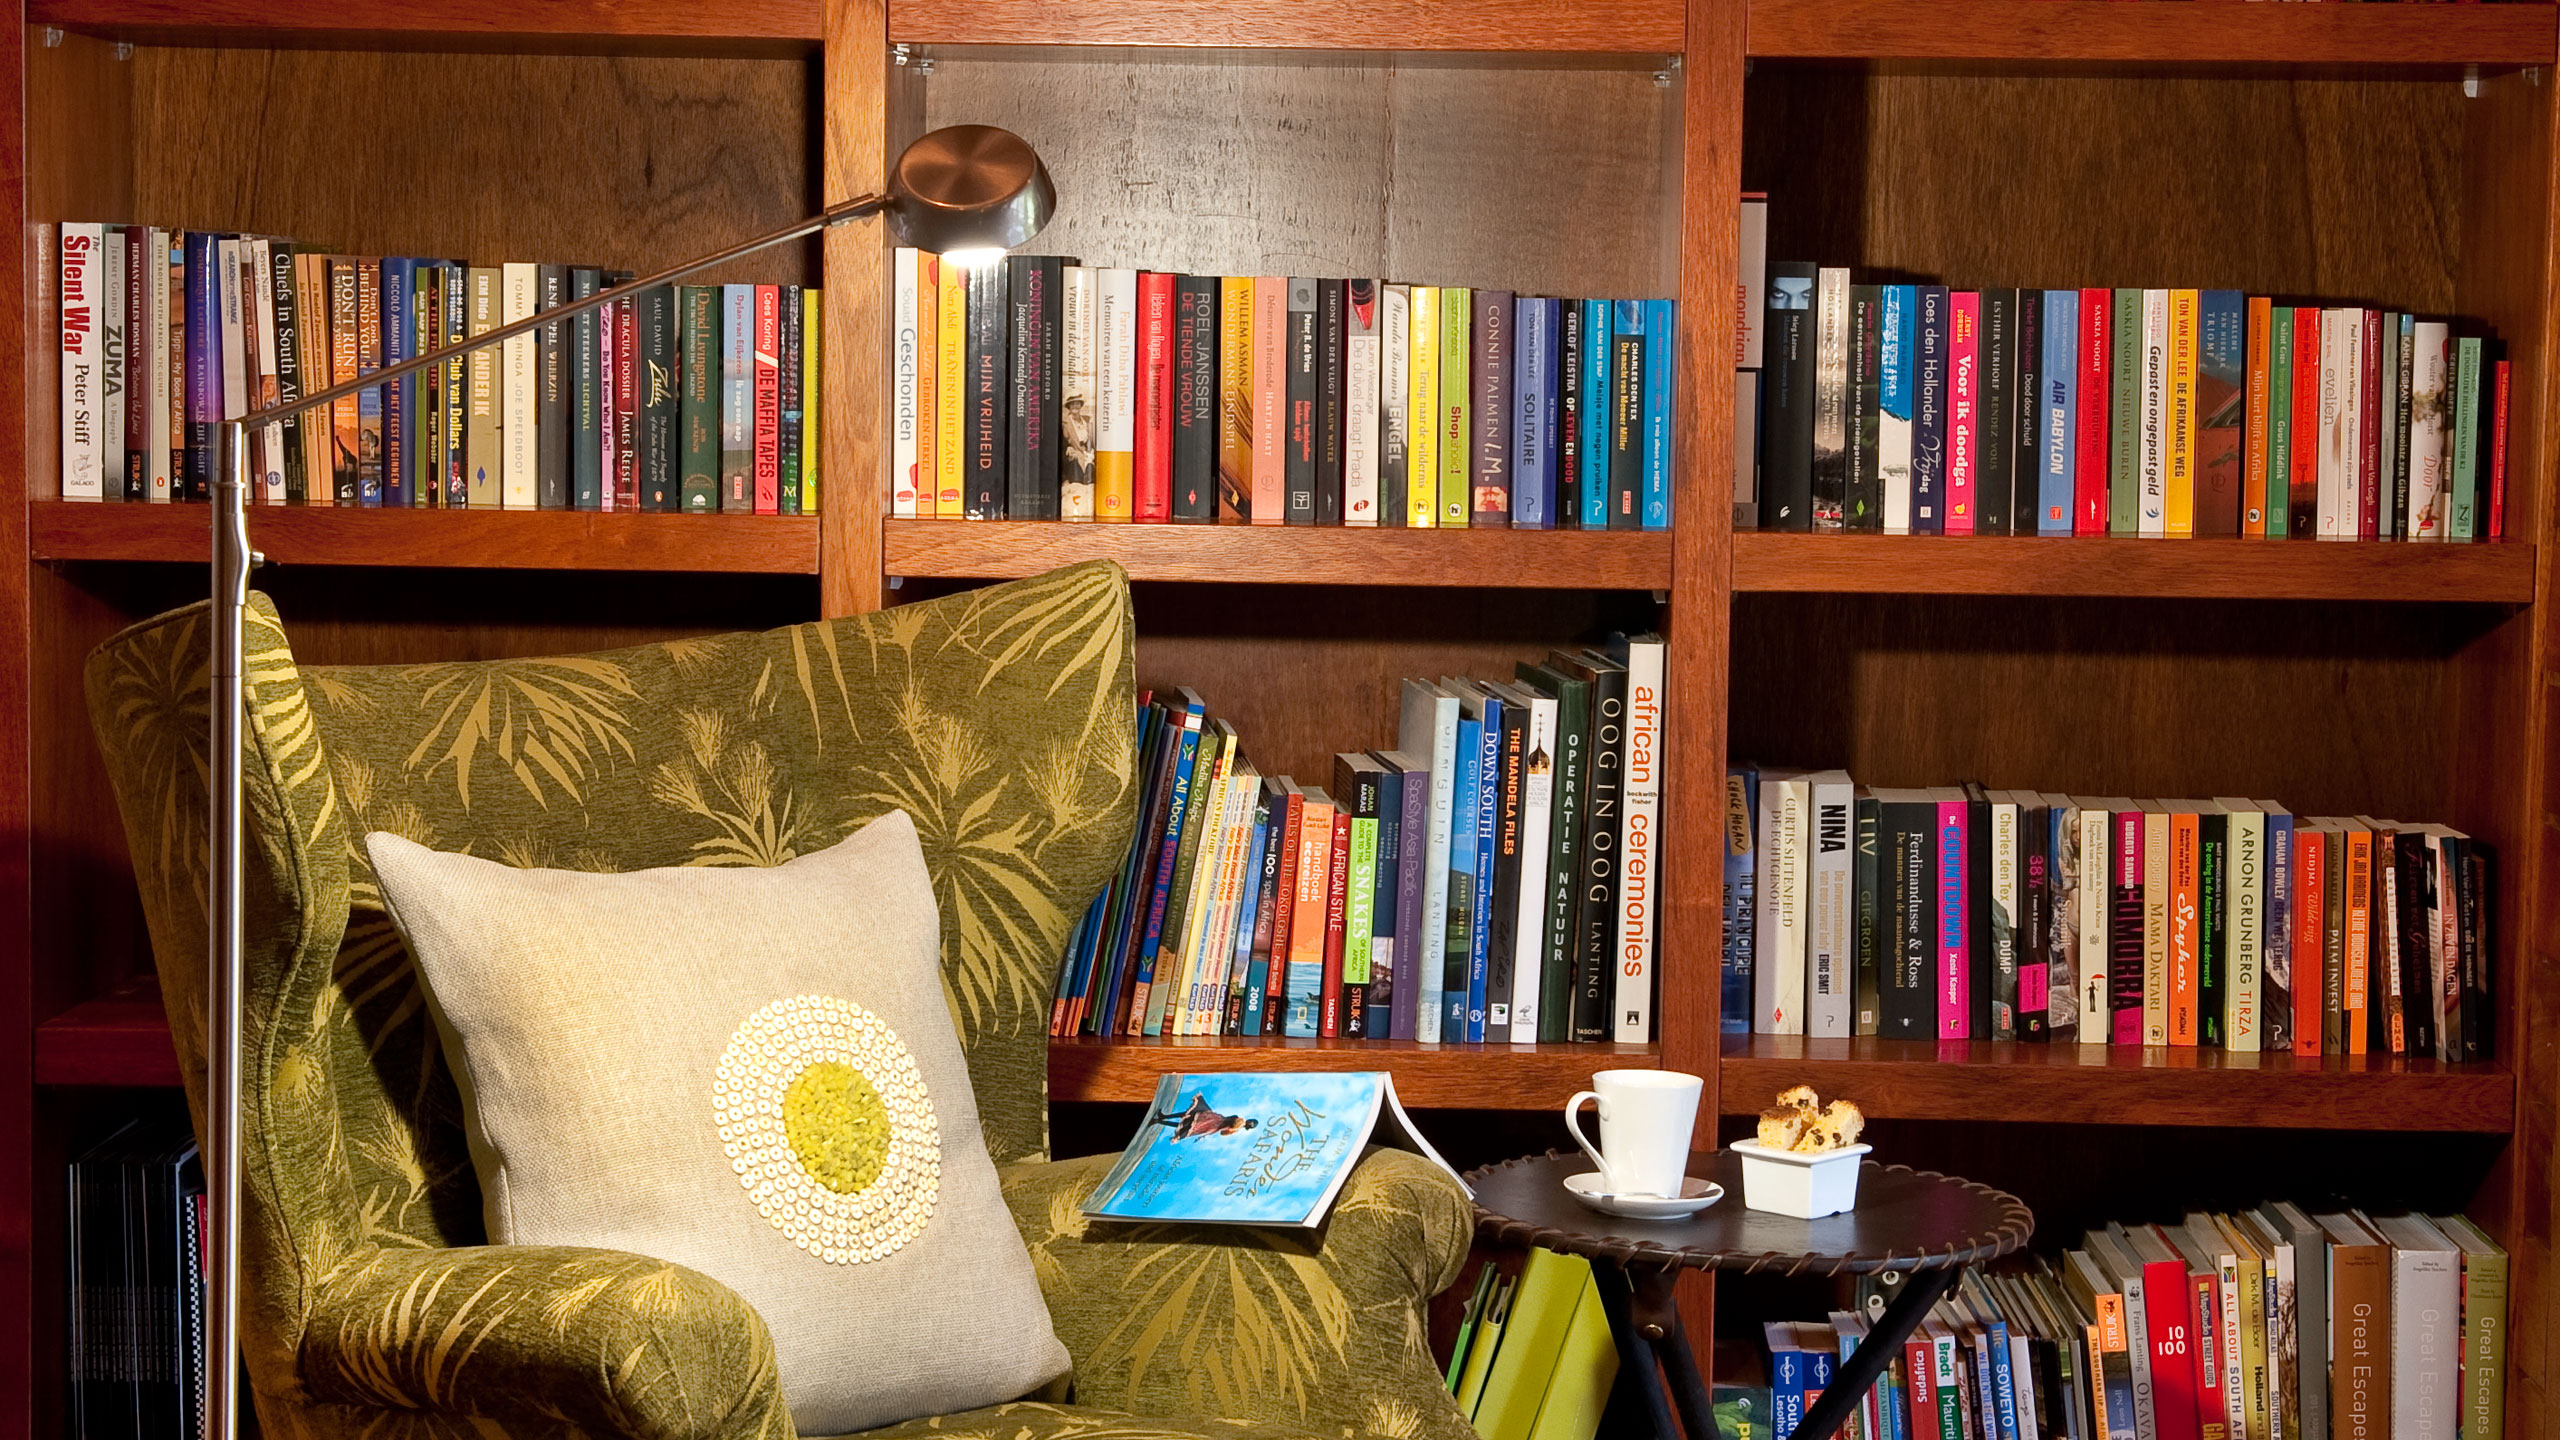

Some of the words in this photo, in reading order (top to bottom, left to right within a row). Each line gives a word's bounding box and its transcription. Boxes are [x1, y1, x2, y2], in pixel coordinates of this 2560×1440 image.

[92, 235, 100, 251] The
[64, 235, 90, 301] Silent
[275, 254, 294, 301] Chiefs
[279, 307, 295, 322] in
[334, 275, 343, 326] whatever
[342, 275, 356, 327] DON'T
[360, 273, 369, 325] BEHIND
[654, 298, 662, 321] SAUL
[698, 293, 710, 329] David
[1182, 292, 1194, 311] DE
[1197, 292, 1210, 338] ROEL
[1240, 289, 1249, 338] WILLEM
[1925, 294, 1939, 323] Loes
[1992, 301, 2001, 340] ESTHER
[2179, 298, 2189, 316] TON
[64, 307, 90, 355] War
[132, 322, 140, 357] BOSMAN
[333, 328, 343, 348] you
[360, 327, 370, 358] YOU!
[622, 314, 631, 357] DRACULA
[654, 325, 662, 355] DAVID
[1016, 303, 1027, 346] Jacqueline
[1104, 295, 1114, 347] Memoires
[1119, 311, 1130, 343] Farah
[1181, 317, 1193, 368] TIENDE
[1488, 305, 1500, 369] CONNIE
[1736, 285, 1752, 362] mondrian
[2178, 319, 2189, 336] VAN
[106, 325, 122, 397] ZUMA
[279, 328, 297, 375] South
[335, 351, 344, 366] do
[343, 334, 357, 367] RUN
[1119, 346, 1130, 370] Diba
[1353, 339, 1365, 358] De
[1924, 329, 1938, 357] den
[2093, 340, 2101, 373] NOORT
[2178, 340, 2188, 357] DER
[74, 364, 89, 405] Peter
[622, 362, 631, 399] DOSSIER
[691, 333, 710, 403] Livingstone
[759, 369, 774, 385] DE
[900, 328, 916, 440] Geschonden
[980, 355, 992, 394] MIJN
[1015, 347, 1027, 383] Kennedy
[1195, 342, 1209, 419] JANSSEN
[1352, 362, 1364, 400] duivel
[1418, 370, 1429, 397] Terug
[1958, 355, 1971, 396] Voor
[1991, 344, 2000, 390] VERHOEF
[2178, 361, 2188, 377] LEE
[1016, 385, 1026, 417] Onassis
[1118, 374, 1128, 416] Pahlawi
[1180, 373, 1192, 427] VROUW
[1487, 376, 1499, 437] PALMEN
[1923, 360, 1938, 427] Hollander
[1957, 401, 1970, 419] ik
[2052, 380, 2066, 404] AIR
[2177, 383, 2187, 395] DE
[2324, 369, 2337, 426] evelien
[74, 410, 90, 445] Stiff
[620, 410, 633, 444] JAMES
[759, 389, 774, 435] MAFFIA
[1102, 390, 1112, 432] keizerin
[1350, 404, 1364, 445] draagt
[1419, 402, 1427, 424] naar
[1419, 427, 1428, 438] de
[1524, 393, 1535, 466] SOLITAIRE
[2176, 398, 2187, 453] AFRIKAANSE
[980, 398, 992, 469] VRIJHEID
[1387, 407, 1402, 464] ENGEL
[2051, 408, 2063, 474] BABYLON
[622, 450, 633, 483] REESE
[759, 440, 774, 477] TAPES
[1418, 442, 1428, 488] wildernis
[1953, 425, 1968, 487] doodga
[2175, 457, 2186, 477] WEG
[2423, 456, 2437, 491] Door
[1509, 728, 1521, 753] THE
[1598, 697, 1621, 769] OOG
[1632, 686, 1658, 783] african
[1484, 732, 1497, 781] DOWN
[1176, 776, 1190, 796] All
[1505, 756, 1520, 818] MANDELA
[1561, 734, 1579, 854] OPERATIE
[1596, 783, 1616, 818] IN
[1166, 796, 1186, 836] About
[1479, 785, 1495, 838] SOUTH
[1771, 810, 1781, 828] DE
[1784, 798, 1795, 844] CURTIS
[1820, 804, 1846, 853] NINA
[1503, 821, 1515, 855] FILES
[2000, 813, 2011, 856] Charles
[2276, 830, 2286, 865] GRAHAM
[1157, 839, 1177, 887] SOUTH
[1300, 841, 1313, 902] ecoreizen
[1311, 841, 1325, 902] handboek
[1331, 848, 1346, 896] AFRICAN
[1589, 832, 1612, 903] OOG
[1769, 831, 1781, 915] ECHTGENOTE
[2000, 860, 2011, 880] den
[2241, 827, 2254, 888] ARNON
[1353, 865, 1371, 938] SNAKES
[1624, 814, 1649, 977] ceremonies
[1783, 848, 1794, 927] SITTENFELD
[1909, 832, 1923, 933] Ferdinandusse
[1944, 826, 1961, 948] COUNTDOWN
[2000, 883, 2011, 902] Tex
[2274, 867, 2285, 899] BOWLEY
[1148, 889, 1168, 938] AFRICA
[1329, 898, 1343, 931] STYLE
[1554, 872, 1568, 961] NATUUR
[2150, 903, 2162, 946] MAMA
[1587, 922, 1602, 999] LANTING
[1909, 939, 1921, 950] &
[1999, 940, 2011, 974] DUMP
[2114, 884, 2144, 1012] GOMORRA
[2175, 893, 2194, 994] Spyker
[2240, 894, 2253, 984] GRUNBERG
[2328, 929, 2338, 963] PALM
[1908, 955, 1921, 988] Ross
[2150, 951, 2162, 1010] DAKTARI
[2328, 968, 2338, 1013] INVEST
[1249, 986, 1260, 1012] 2008
[1327, 998, 1335, 1029] TASCHEN
[2239, 991, 2251, 1036] TIRZA
[1223, 1115, 1287, 1198] SAFARIS
[1298, 1135, 1331, 1173] THE
[2133, 1311, 2143, 1336] Frans
[2226, 1293, 2235, 1315] ALL
[2228, 1321, 2237, 1361] ABOUT
[2353, 1304, 2371, 1358] Great
[2421, 1309, 2439, 1363] Great
[2480, 1317, 2495, 1360] Great
[1915, 1350, 1927, 1403] Sudafrica
[1939, 1343, 1951, 1376] Bradt
[2135, 1338, 2144, 1372] Lanting
[1996, 1364, 2013, 1427] SOWETO
[2230, 1367, 2241, 1413] SOUTH
[2255, 1366, 2265, 1411] Holland
[2475, 1368, 2494, 1434] Escapes
